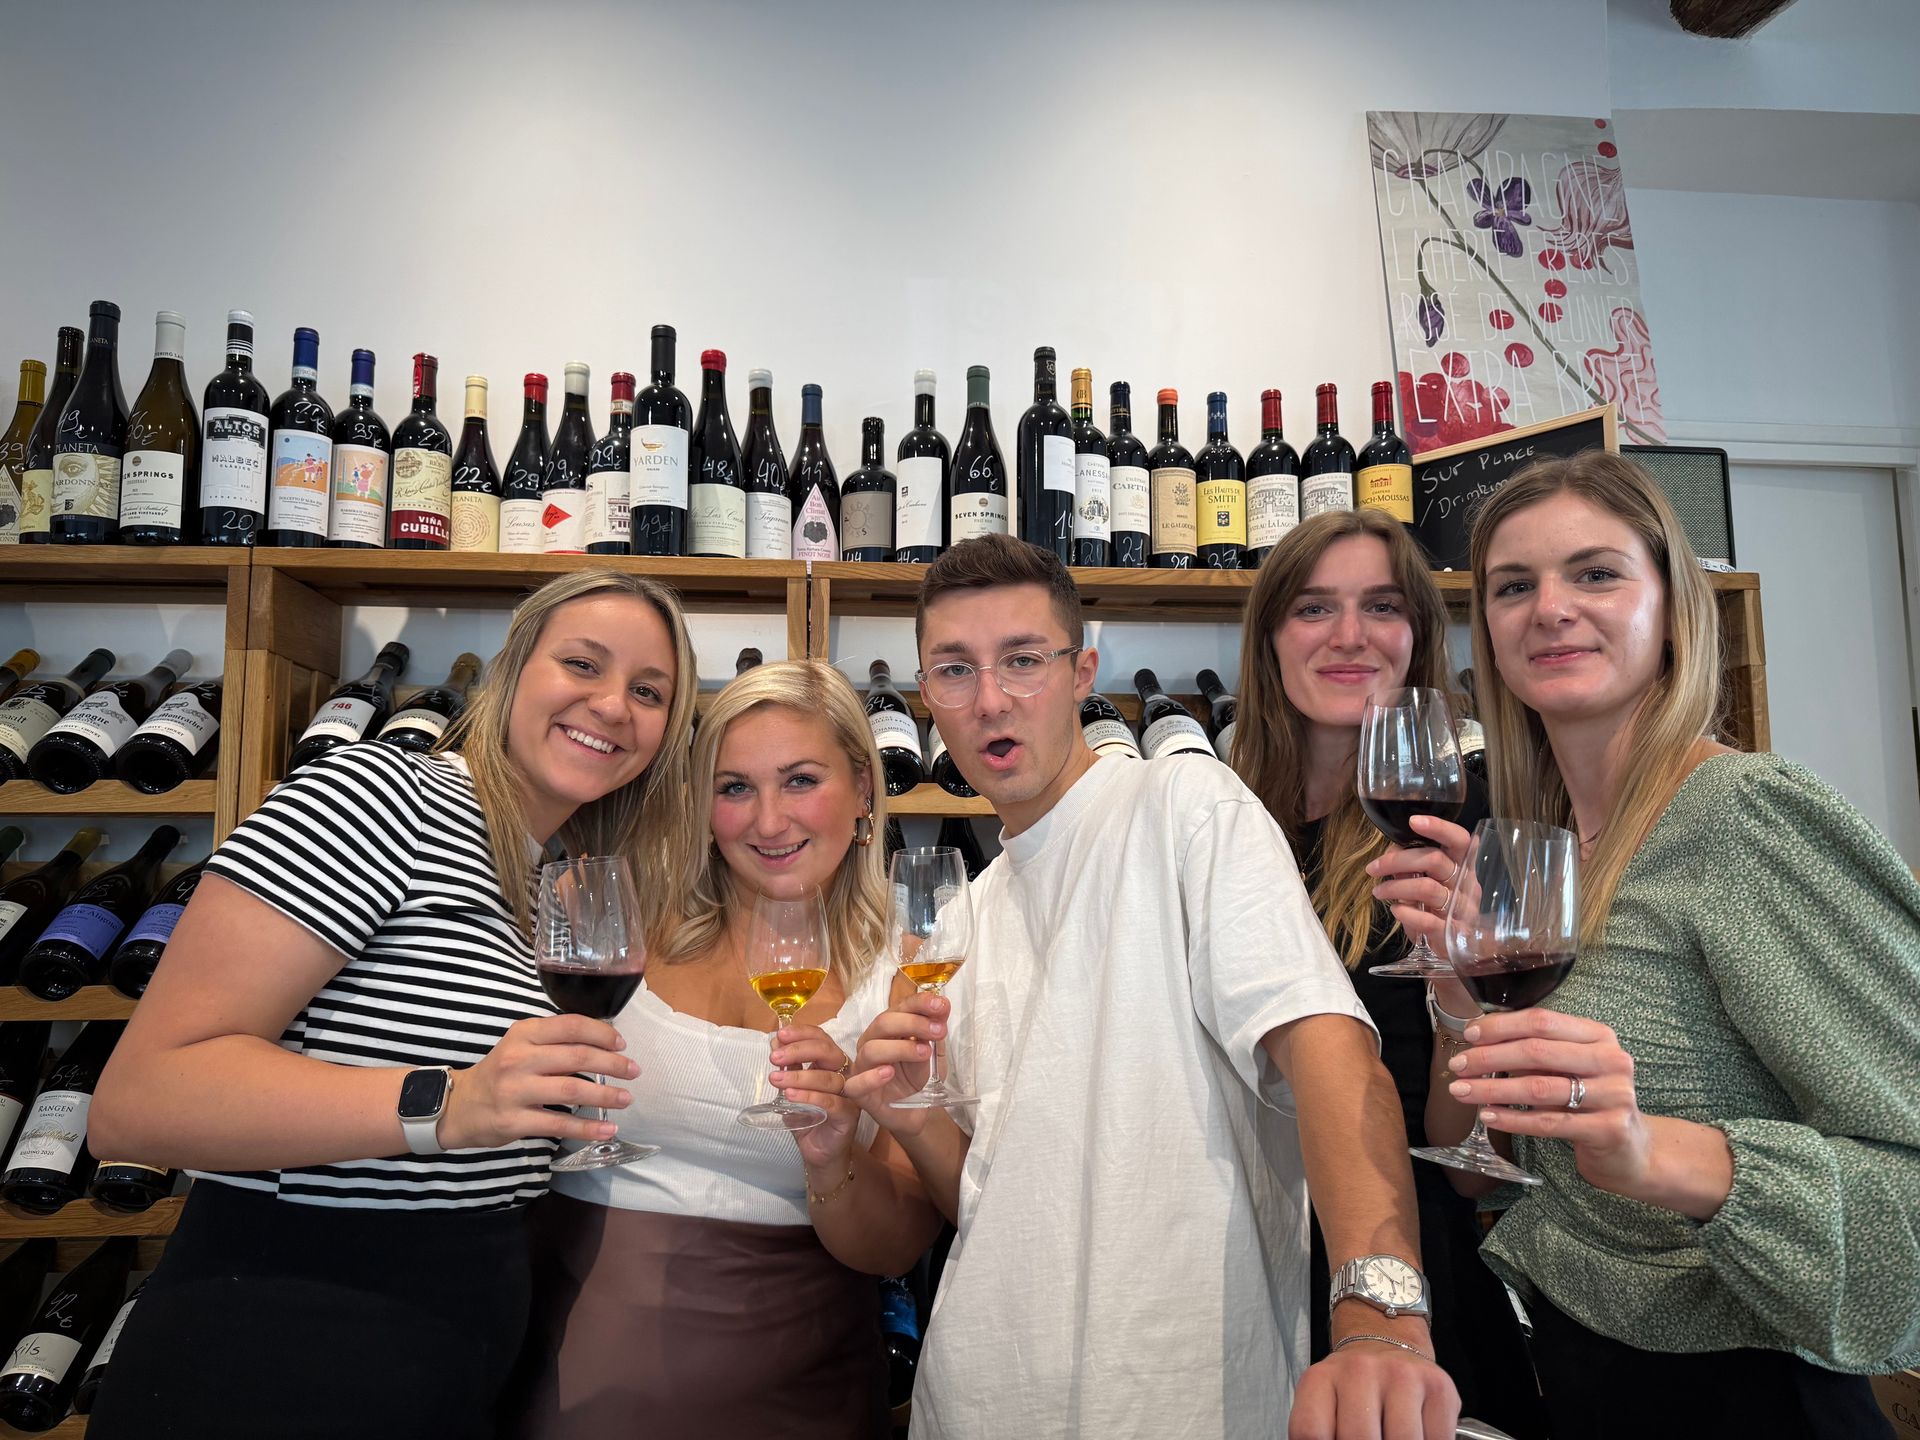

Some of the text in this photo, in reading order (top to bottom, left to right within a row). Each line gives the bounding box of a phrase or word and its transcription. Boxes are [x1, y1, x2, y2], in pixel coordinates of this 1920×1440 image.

[1381, 149, 1620, 223] CHAMPAGNE
[1391, 227, 1515, 283] LAHERTE
[1399, 286, 1650, 347] ROSÉ DE MEUNIER
[1408, 348, 1645, 426] EXTRA BRUT
[214, 420, 260, 435] ALTOS
[211, 454, 259, 468] MALBEC
[591, 444, 614, 469] 29
[634, 454, 679, 467] YARDEN
[702, 456, 728, 479] 48
[970, 455, 994, 479] 66
[132, 471, 175, 480] SPRINGS
[454, 466, 482, 485] 22
[1203, 487, 1214, 495] LES
[1214, 486, 1234, 494] HAUTS
[453, 495, 482, 503] PLANETA
[1208, 495, 1237, 503] SMITH
[222, 510, 254, 531] 20
[419, 516, 442, 527] VIÑA
[955, 511, 978, 519] SEVEN
[331, 702, 353, 710] 746
[38, 1105, 74, 1113] RANGEN
